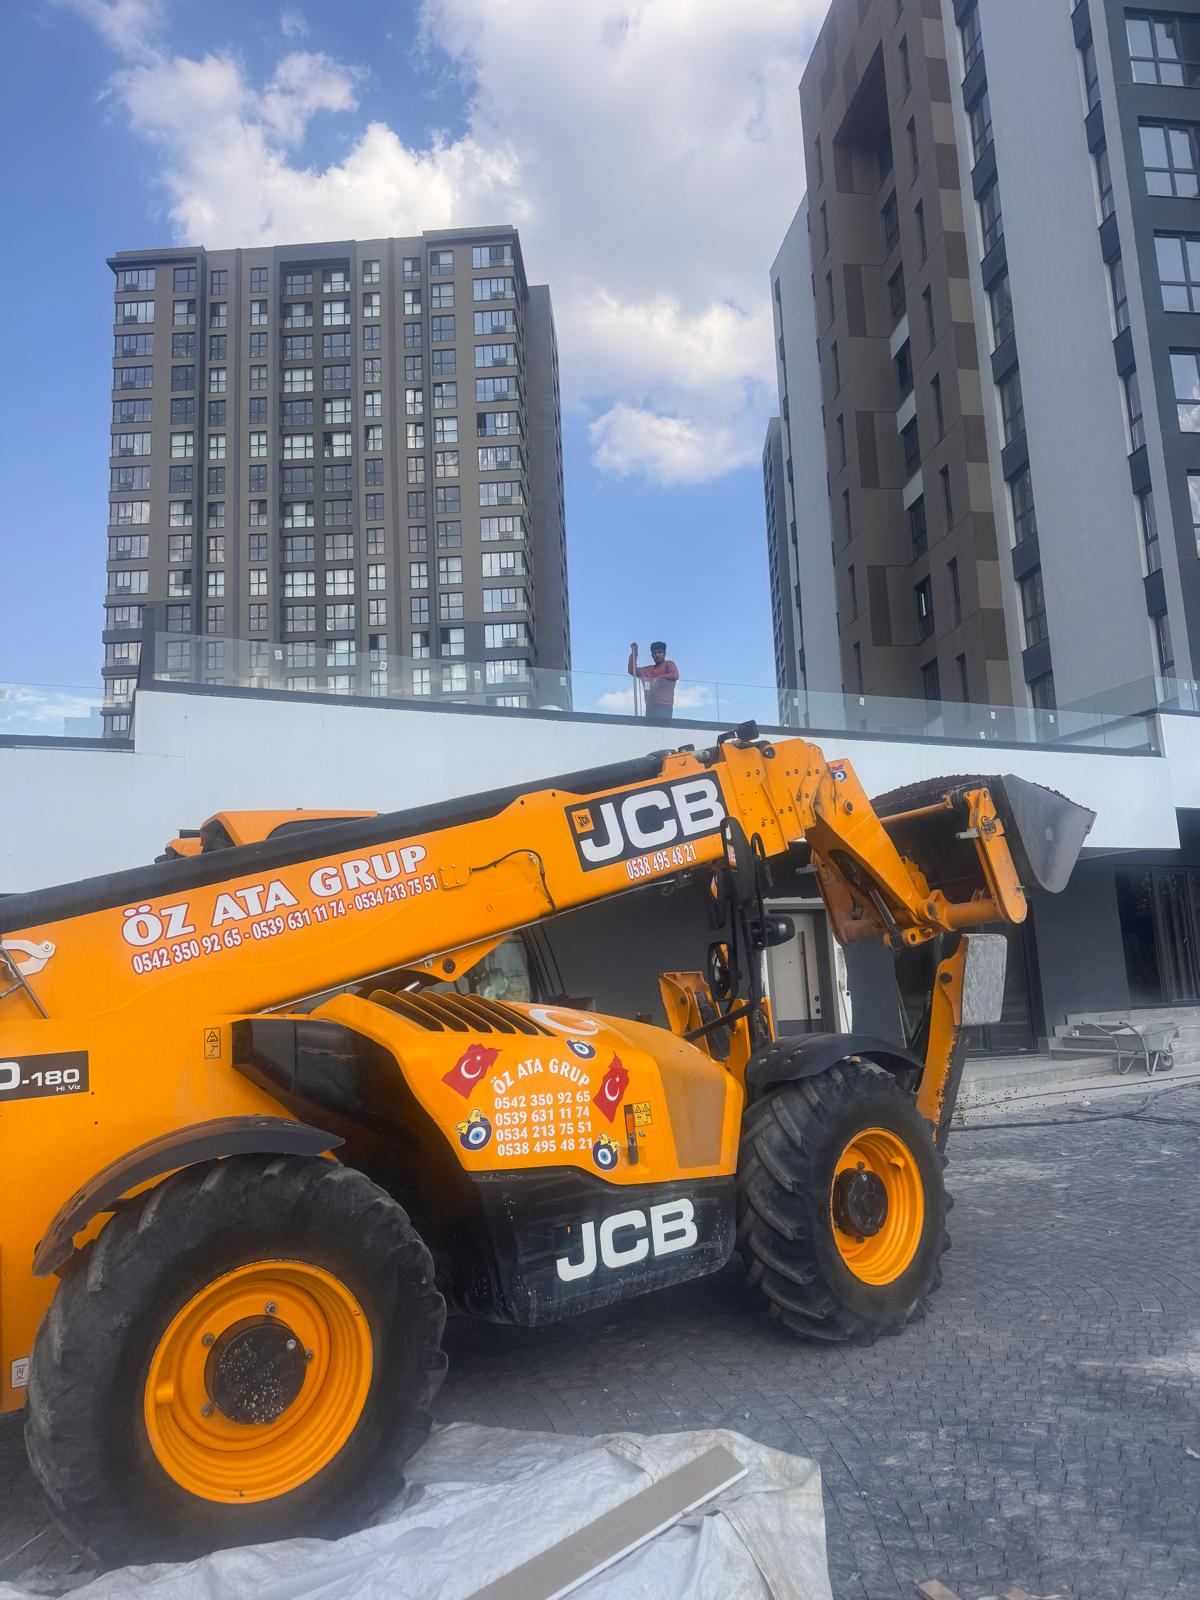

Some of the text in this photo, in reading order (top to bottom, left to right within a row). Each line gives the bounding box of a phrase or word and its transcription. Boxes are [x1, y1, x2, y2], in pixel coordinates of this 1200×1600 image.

[580, 778, 726, 862] JCB
[626, 843, 697, 880] 0538 495 48 21
[122, 844, 427, 946] ÖZ ATA GRUP
[132, 947, 170, 975] 0542
[171, 938, 201, 964] 350
[202, 933, 222, 955] 92
[224, 927, 242, 949] 65
[251, 915, 285, 941] 0539
[287, 907, 312, 931] 631
[313, 902, 328, 923] 11
[328, 898, 346, 918] 74
[354, 887, 384, 911] 0534
[385, 881, 408, 903] 213
[407, 877, 423, 896] 75
[424, 872, 438, 892] 51
[491, 1058, 590, 1095] ÖZ ATA GRUP
[494, 1090, 591, 1110] 0542 350 92 65
[495, 1105, 590, 1126] 0539 631 11 74
[496, 1121, 592, 1142] 0534 213 75 51
[497, 1137, 593, 1157] 0538 495 48 21
[556, 1198, 698, 1282] JCB
